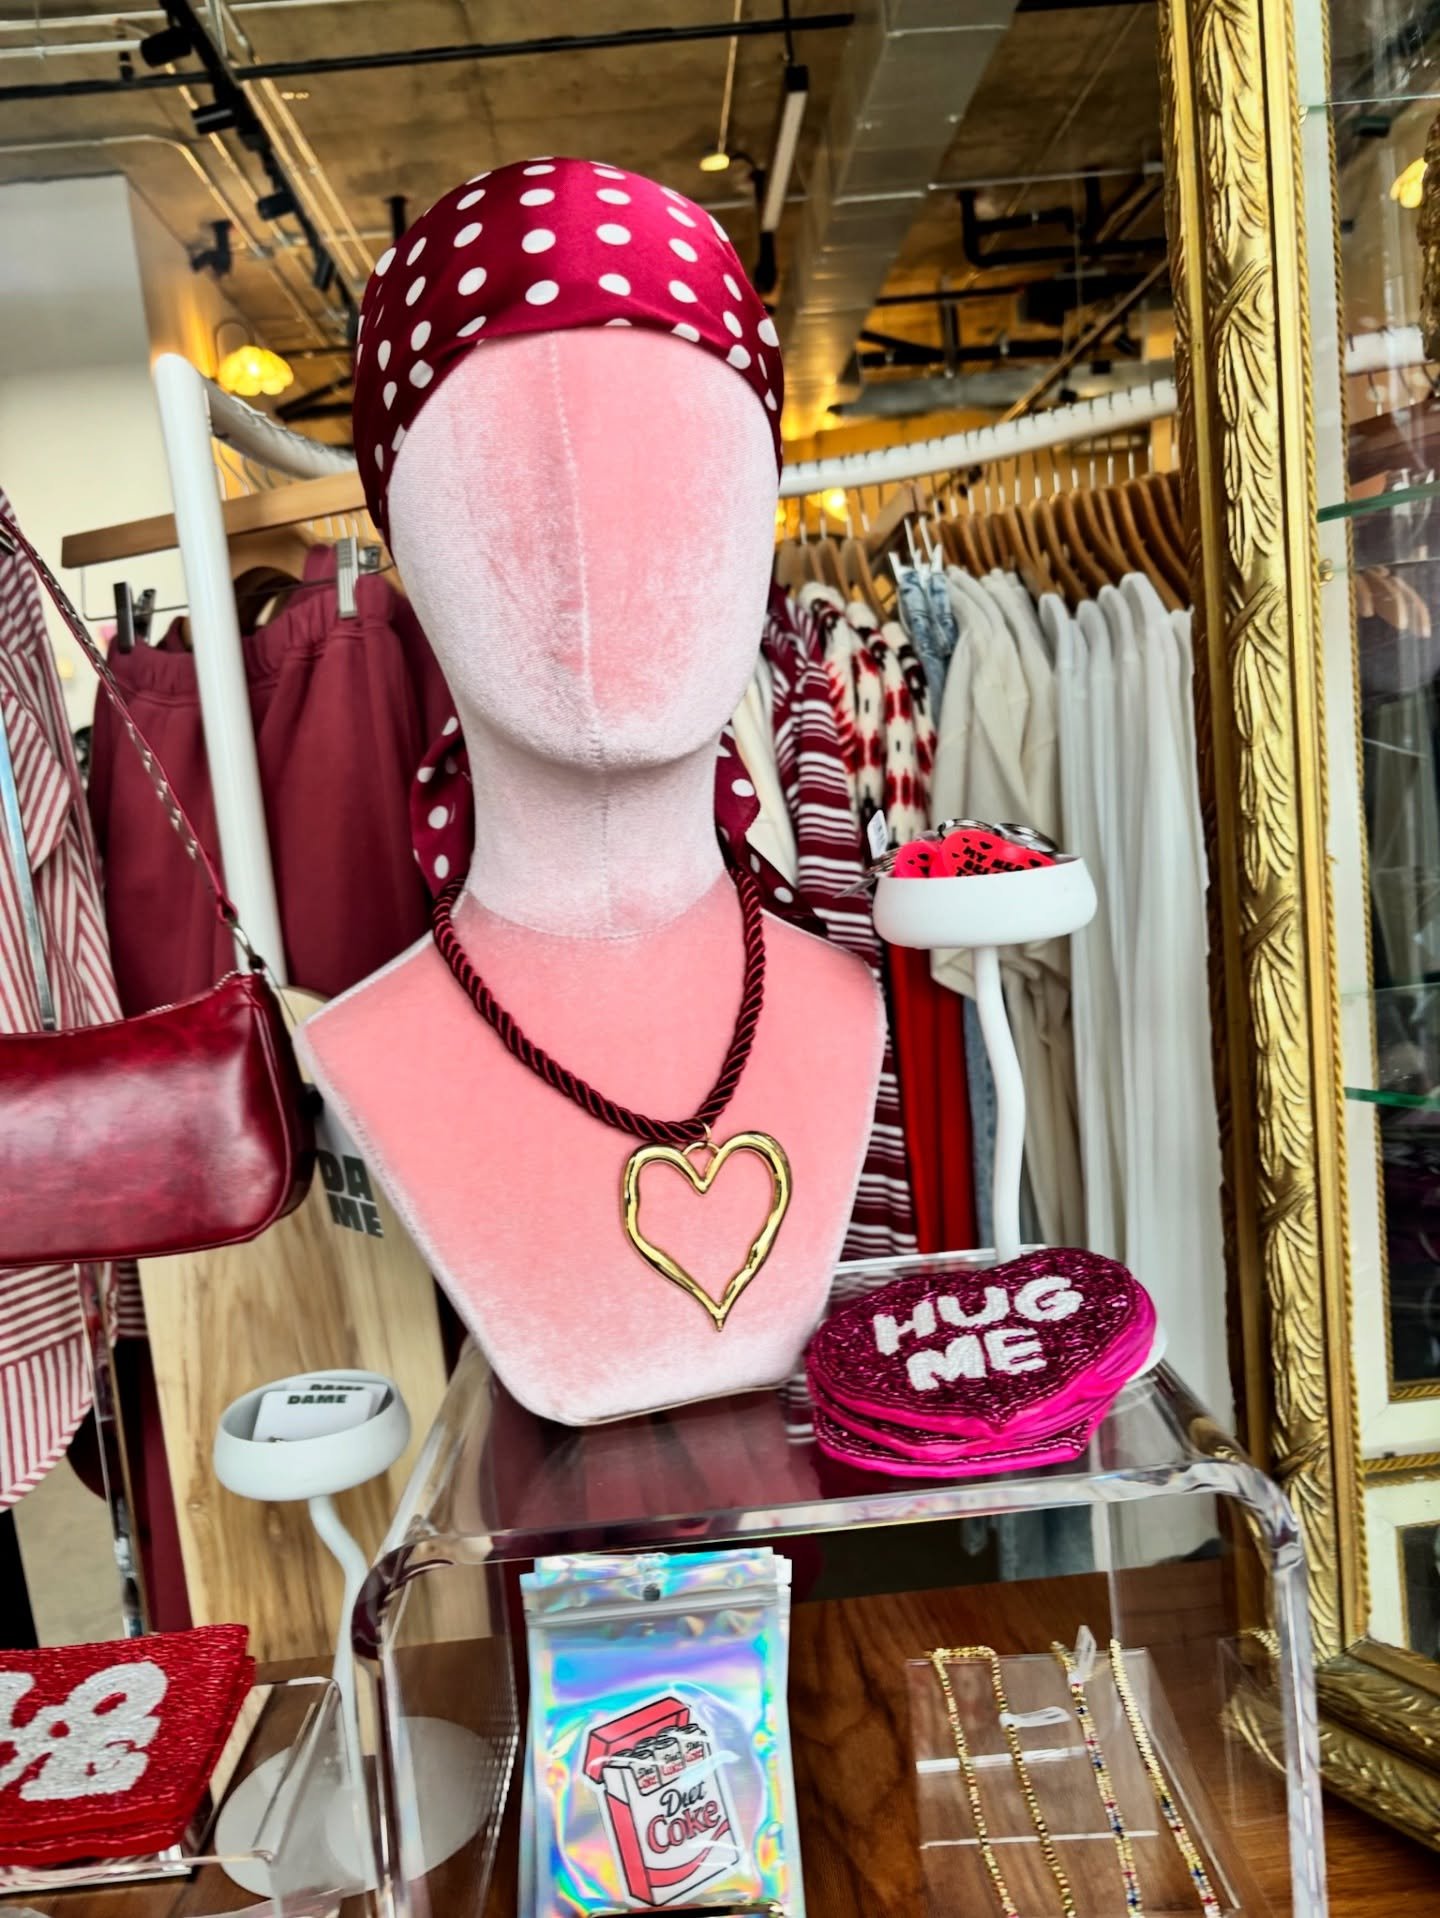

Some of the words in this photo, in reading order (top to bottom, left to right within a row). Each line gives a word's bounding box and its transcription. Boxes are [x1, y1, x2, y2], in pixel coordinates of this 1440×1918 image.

[327, 1193, 384, 1238] ME
[872, 1276, 1084, 1356] HUG
[906, 1328, 1048, 1392] ME
[287, 1394, 348, 1404] DAME
[659, 1781, 706, 1817] Diet
[646, 1800, 721, 1854] Coke
